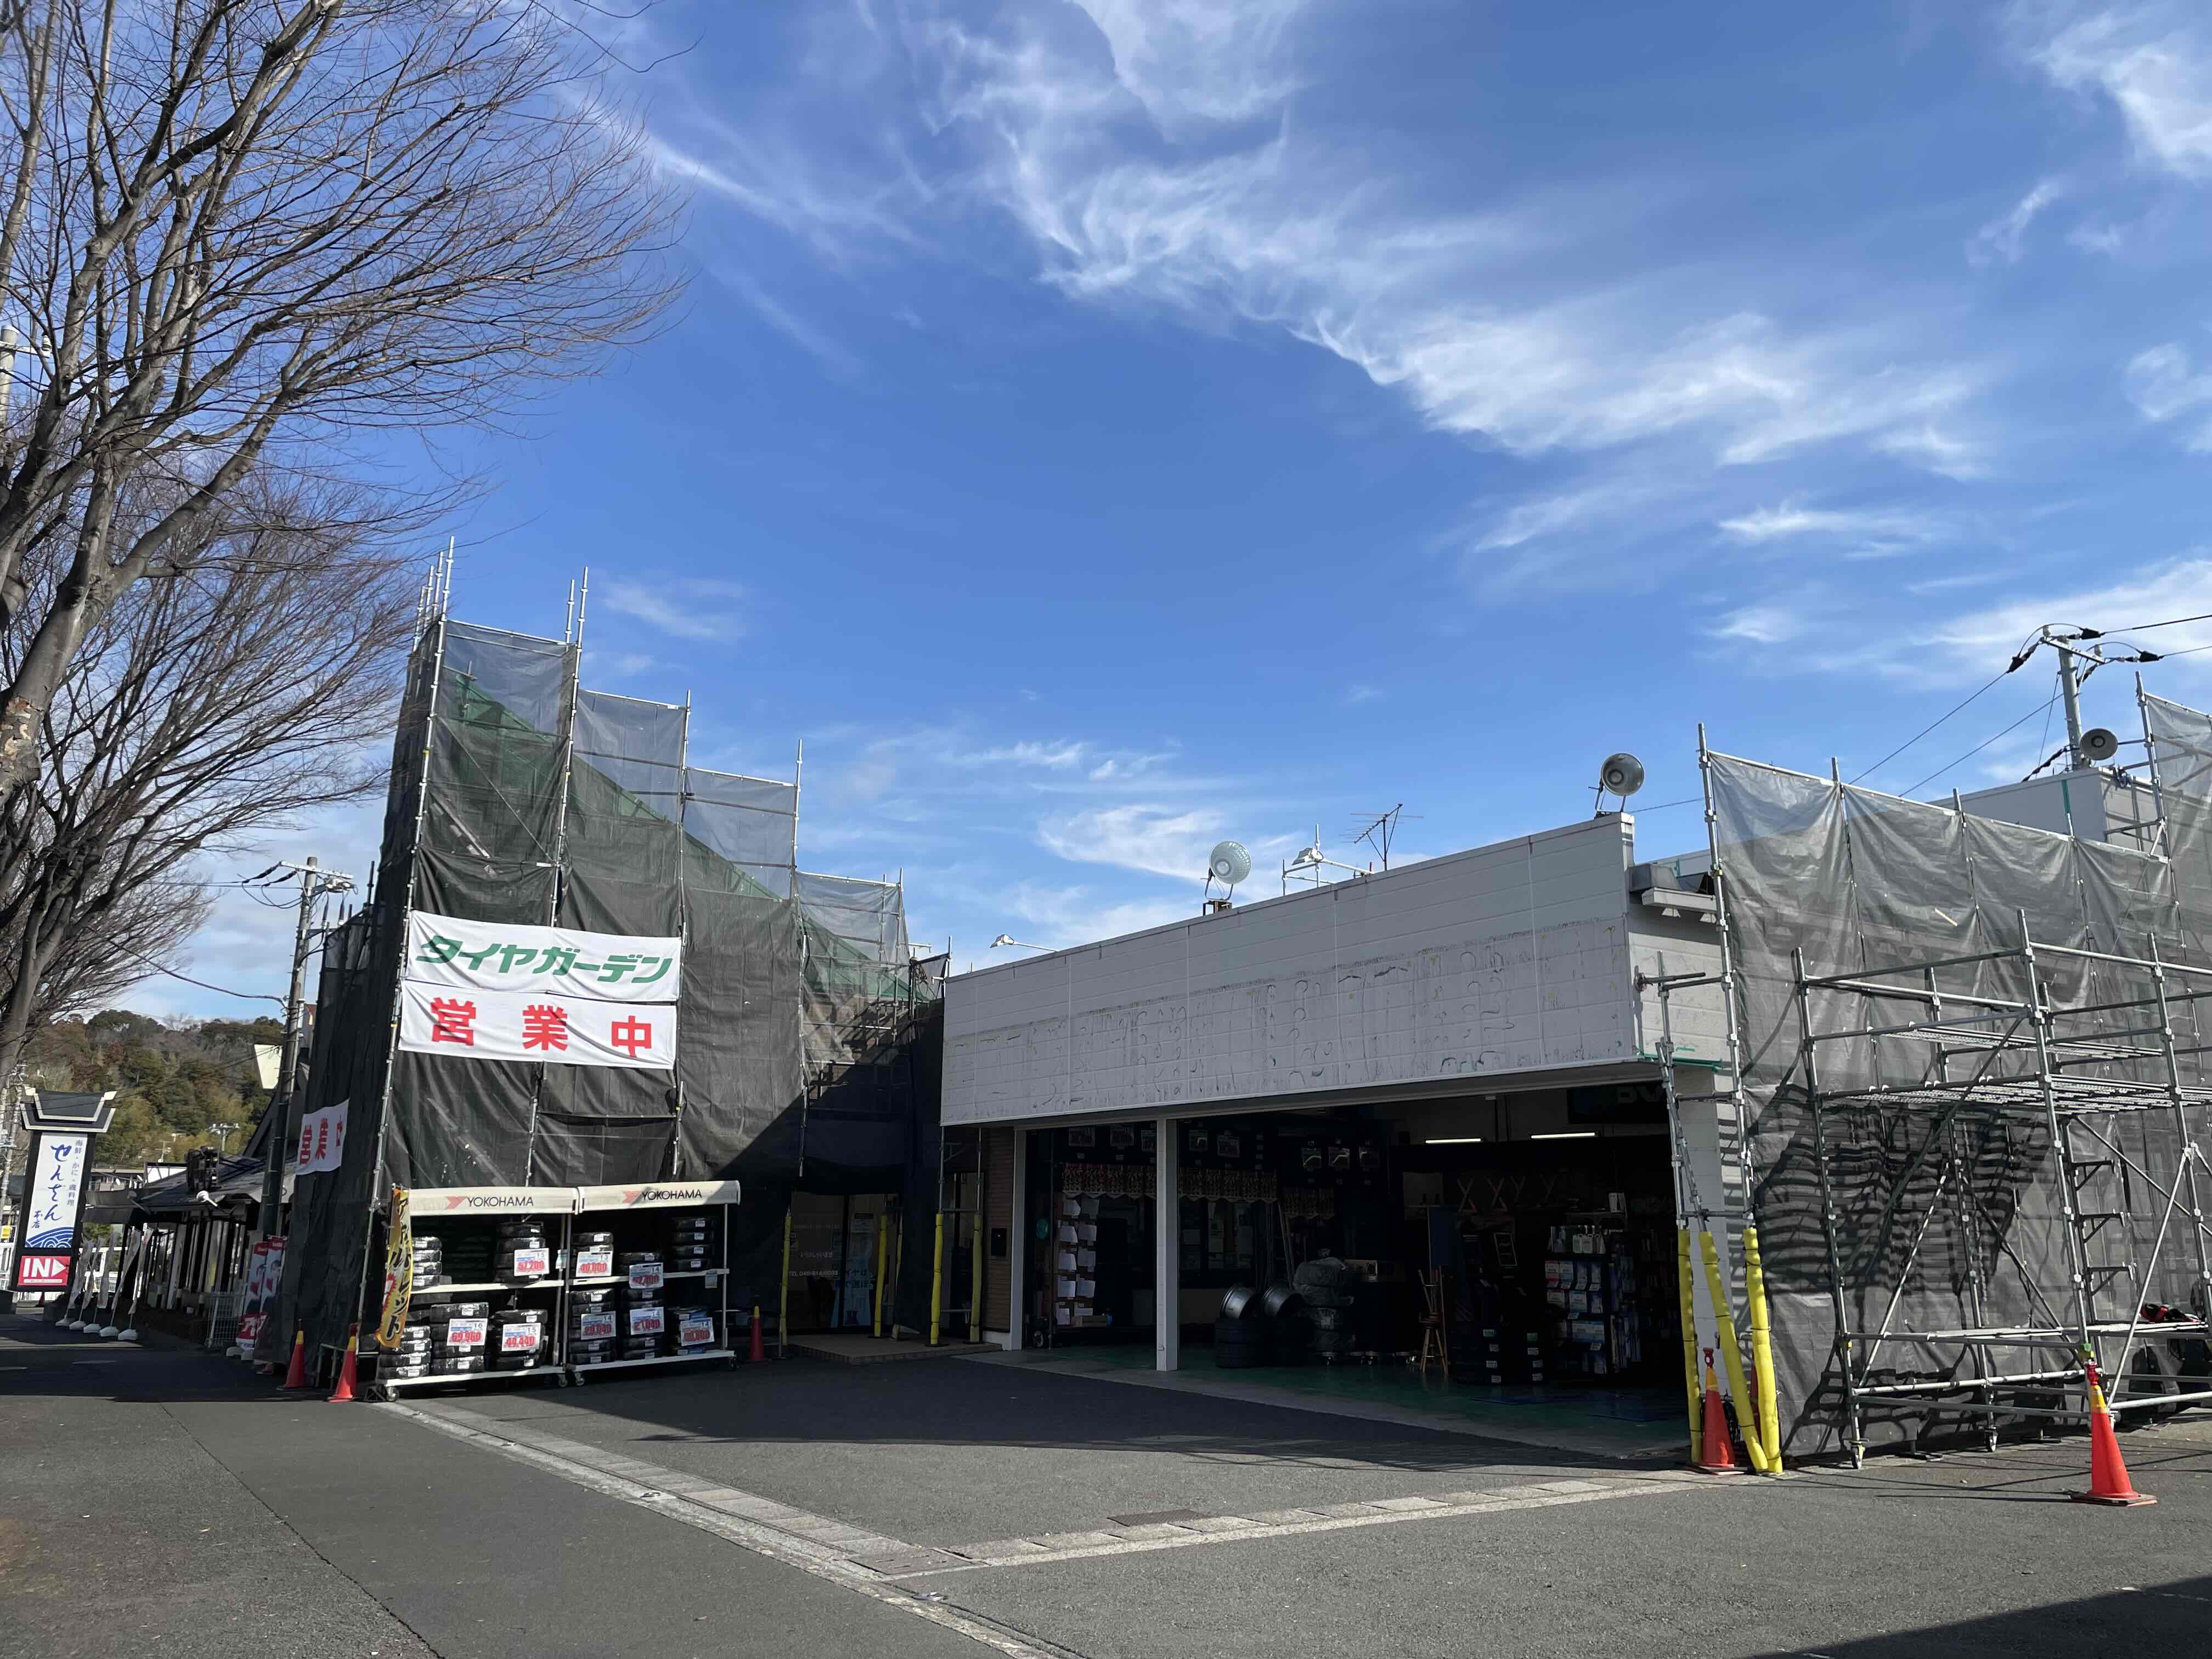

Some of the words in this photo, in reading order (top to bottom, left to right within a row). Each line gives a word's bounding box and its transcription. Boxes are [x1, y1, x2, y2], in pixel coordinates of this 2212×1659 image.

[415, 935, 673, 984] タイヤガーデン
[430, 997, 652, 1058] 営業中
[467, 1197, 534, 1207] YOKOHAMA
[641, 1189, 702, 1201] YOKOHAMA
[23, 1258, 50, 1277] IN
